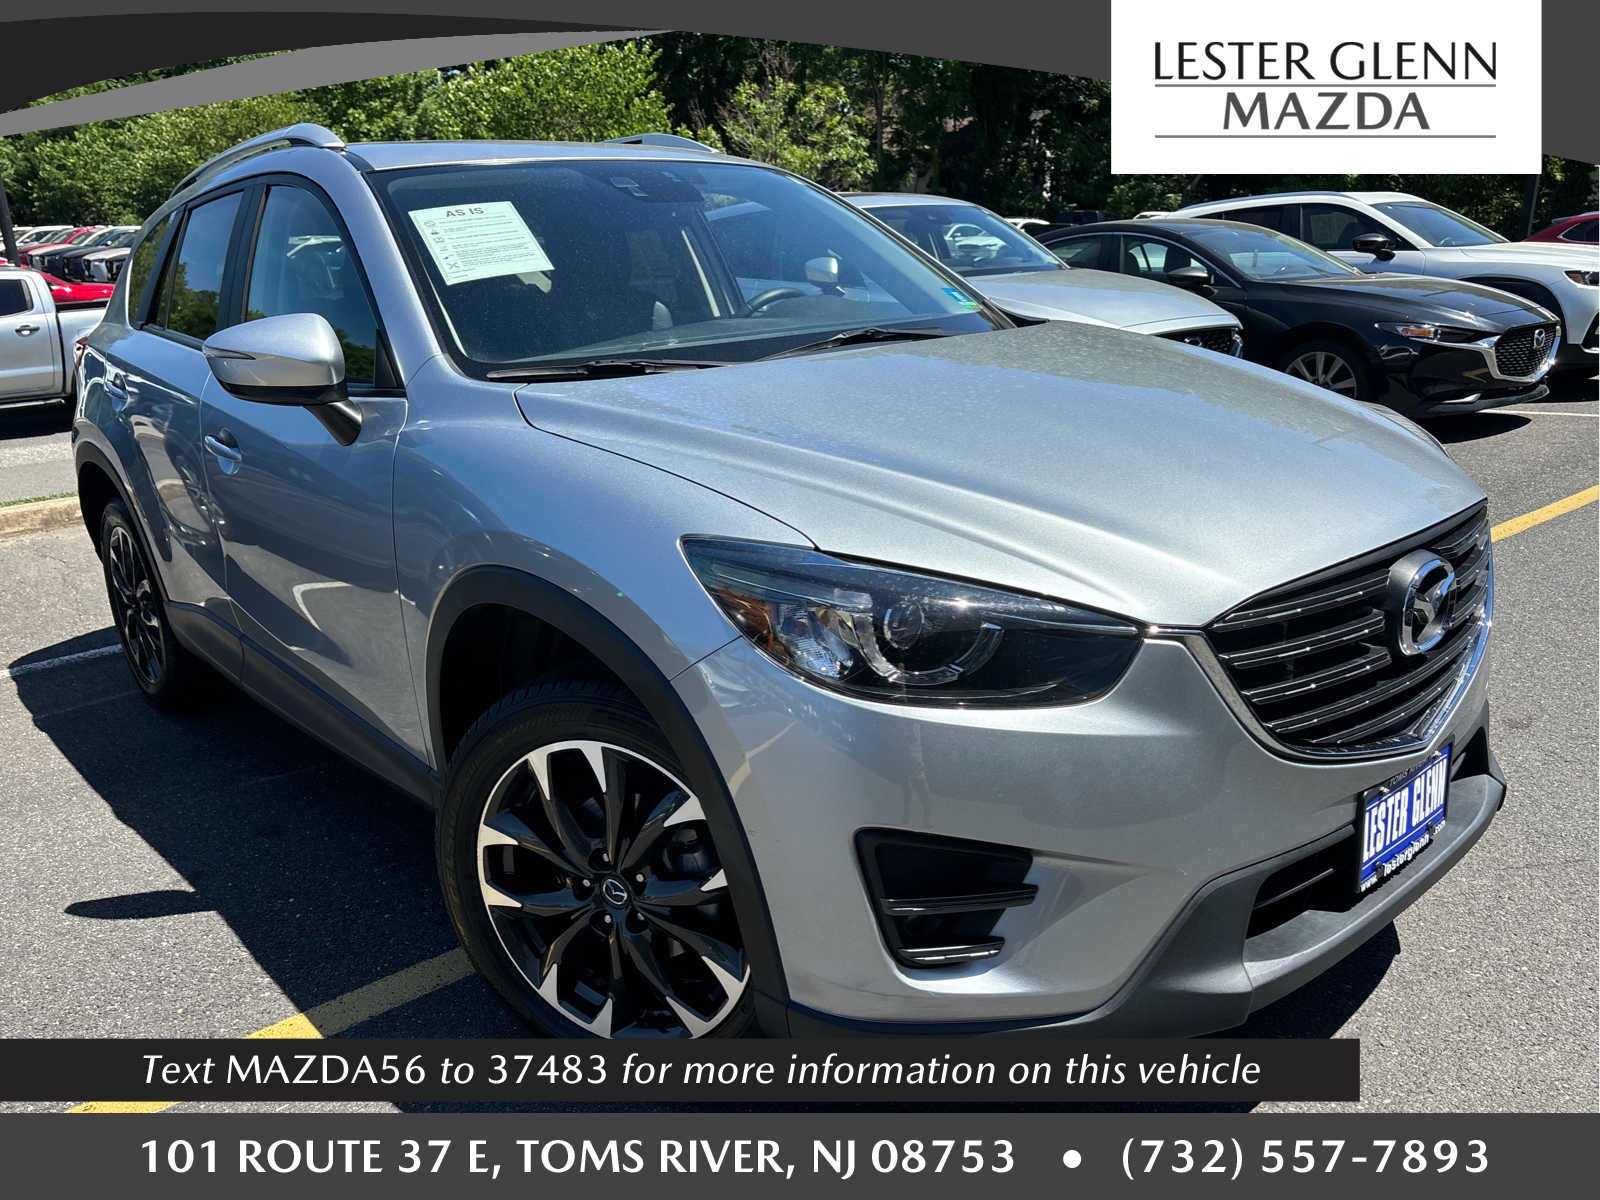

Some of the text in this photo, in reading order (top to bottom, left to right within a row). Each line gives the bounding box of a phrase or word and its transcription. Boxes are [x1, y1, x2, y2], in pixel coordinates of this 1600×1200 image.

[445, 207, 485, 218] AS IS
[1362, 758, 1448, 863] LESTER GLENN
